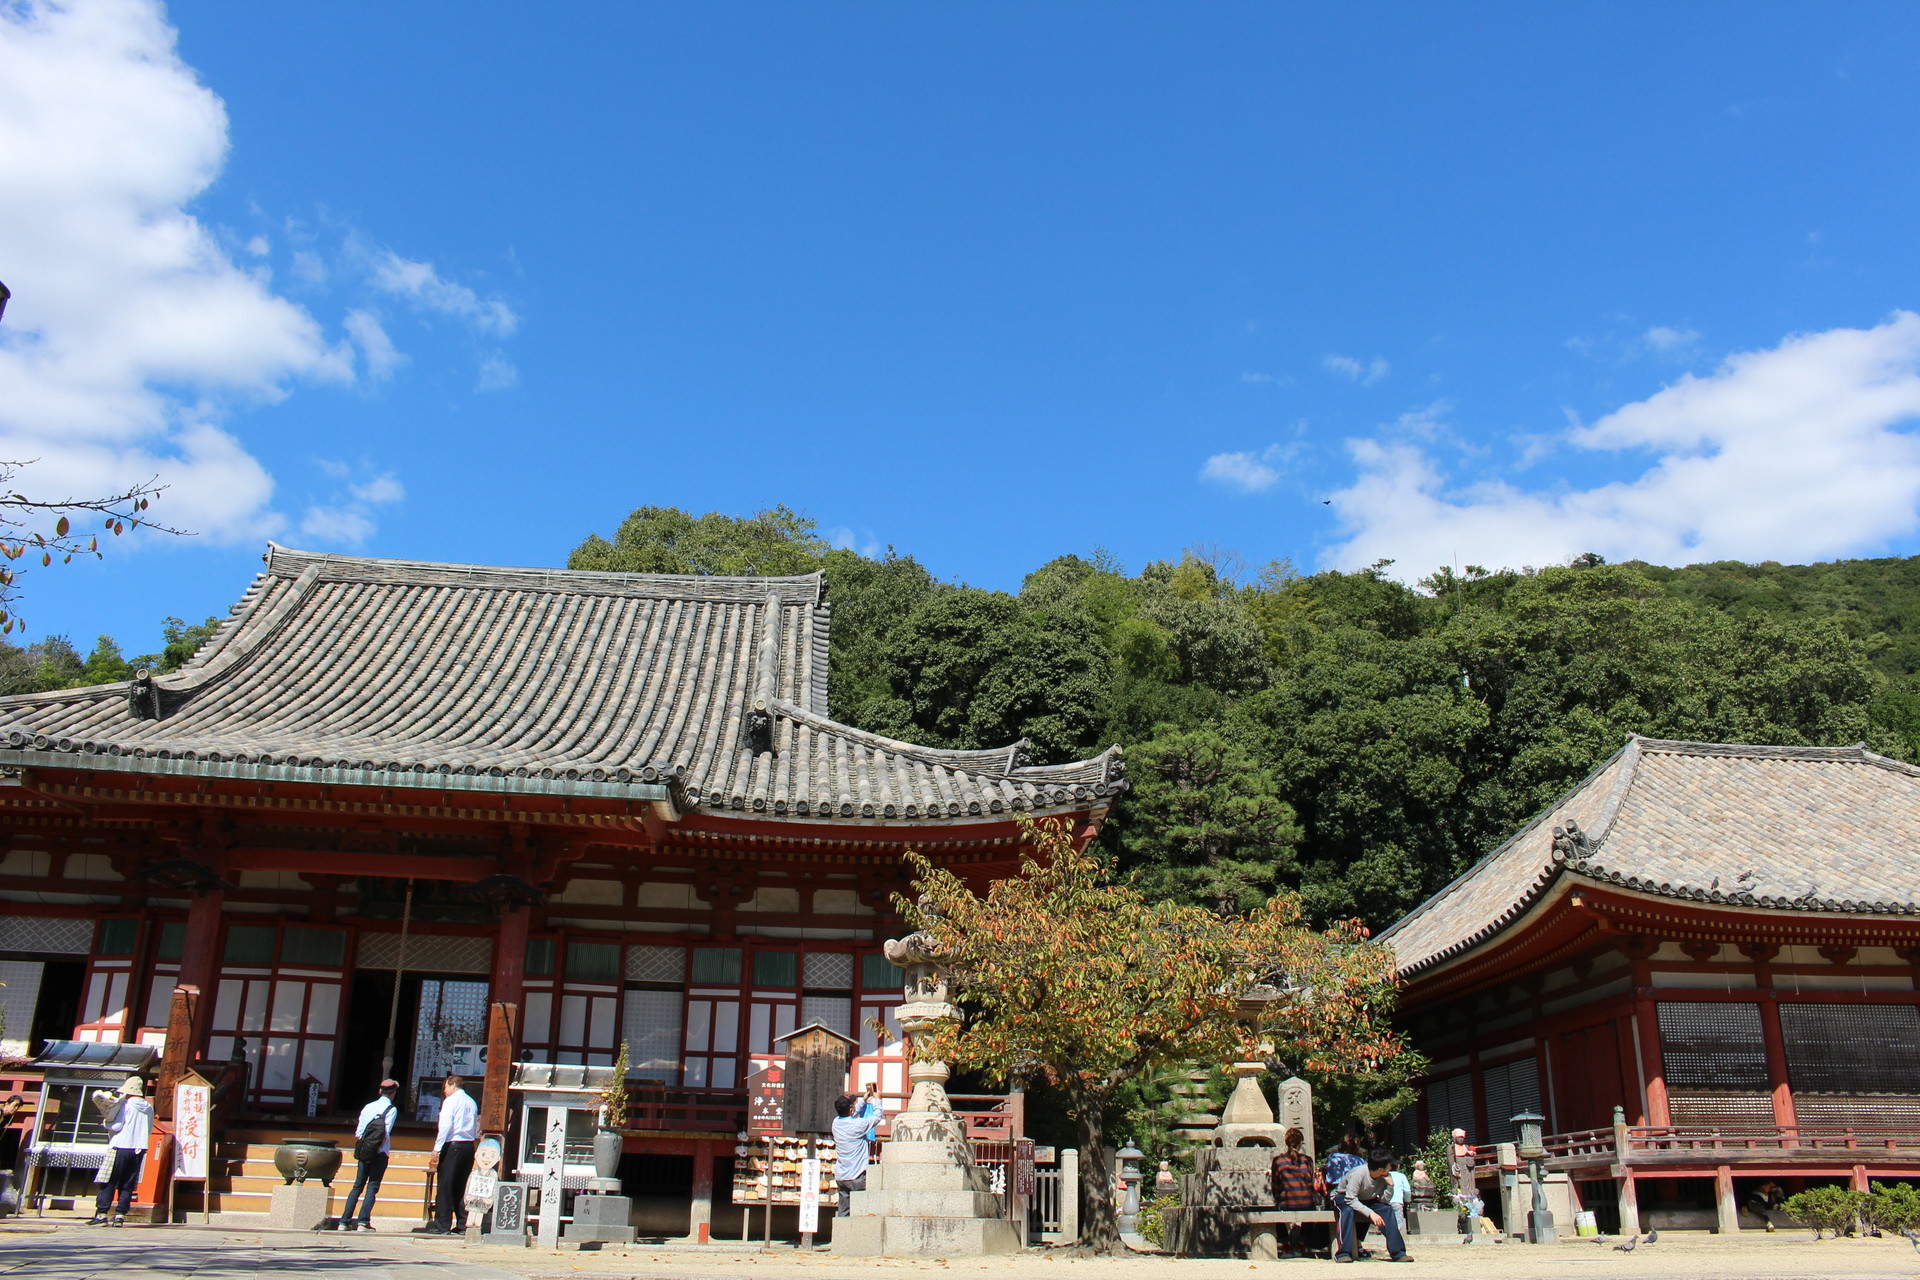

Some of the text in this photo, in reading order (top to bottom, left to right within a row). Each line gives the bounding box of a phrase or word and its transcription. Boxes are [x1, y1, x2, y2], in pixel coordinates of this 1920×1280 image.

[754, 1096, 784, 1107] 浄土
[181, 1116, 200, 1159] 受付
[544, 1119, 563, 1205] 大慈大悲
